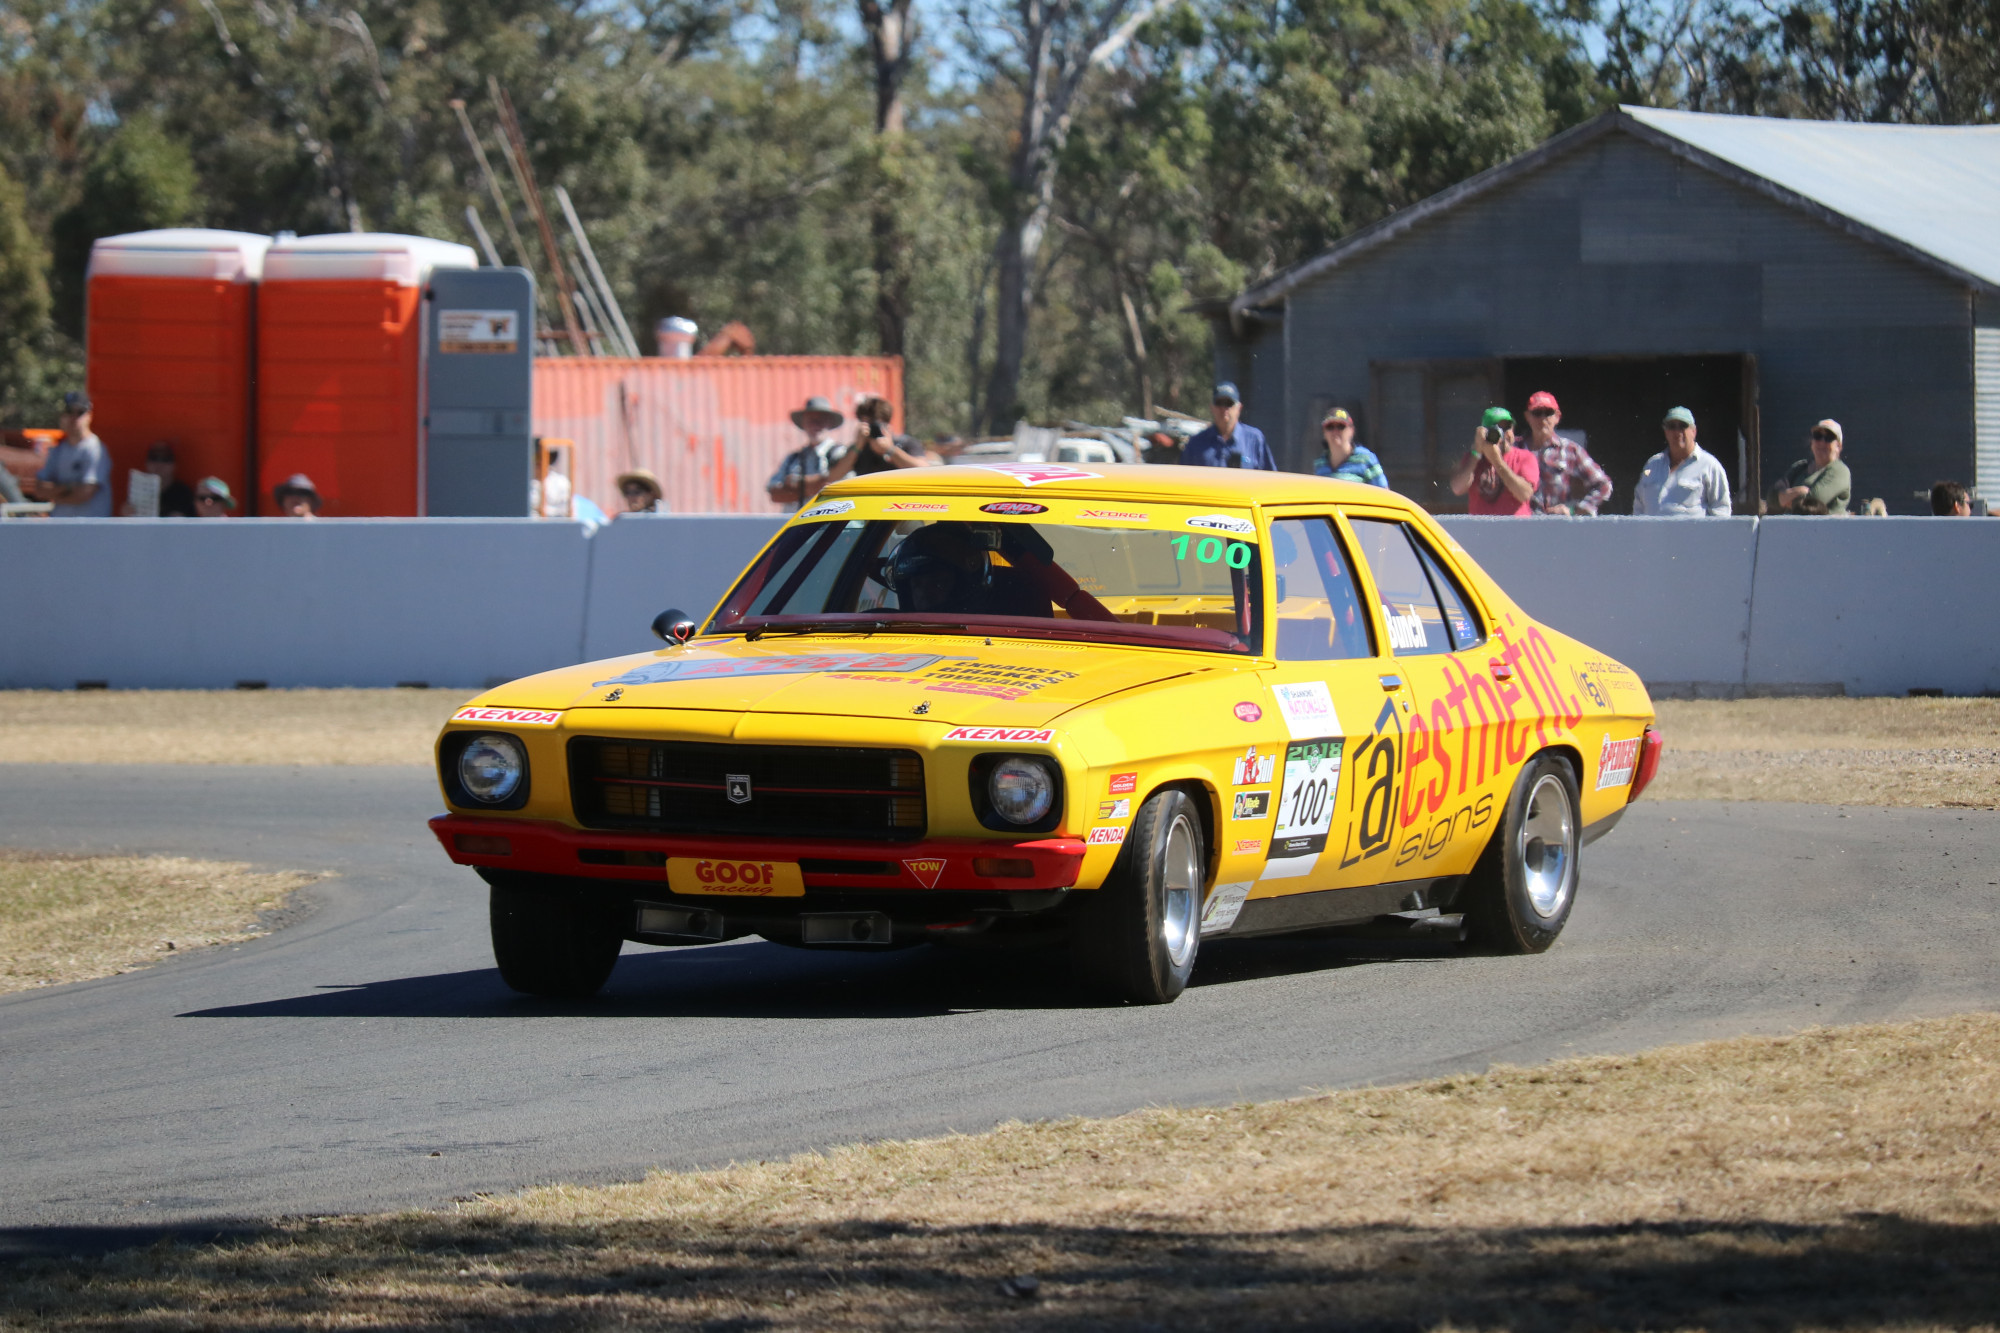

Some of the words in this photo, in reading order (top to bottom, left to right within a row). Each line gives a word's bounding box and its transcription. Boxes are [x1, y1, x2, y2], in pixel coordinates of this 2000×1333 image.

[983, 502, 1043, 512] KENDA
[1081, 509, 1149, 519] XFORCE
[1170, 533, 1252, 570] 100
[1382, 603, 1428, 649] Bunch
[680, 661, 908, 676] AUTO
[937, 666, 1064, 684] BRAKES
[955, 661, 1080, 679] EXHAUSTS
[824, 673, 926, 684] 4661
[937, 680, 1032, 697] 1535
[923, 672, 1046, 690] TOWBARS
[458, 708, 560, 723] KENDA
[1237, 703, 1261, 717] KENDA
[1287, 698, 1328, 716] NATIONALS
[947, 728, 1053, 742] KENDA
[1287, 741, 1344, 762] 2018
[1606, 738, 1638, 772] PEDDERS
[1289, 778, 1329, 827] 100
[1088, 828, 1125, 843] KENDA
[1396, 793, 1493, 868] signs
[696, 860, 775, 885] GOOF
[910, 861, 940, 872] TOW
[702, 885, 775, 897] racing
